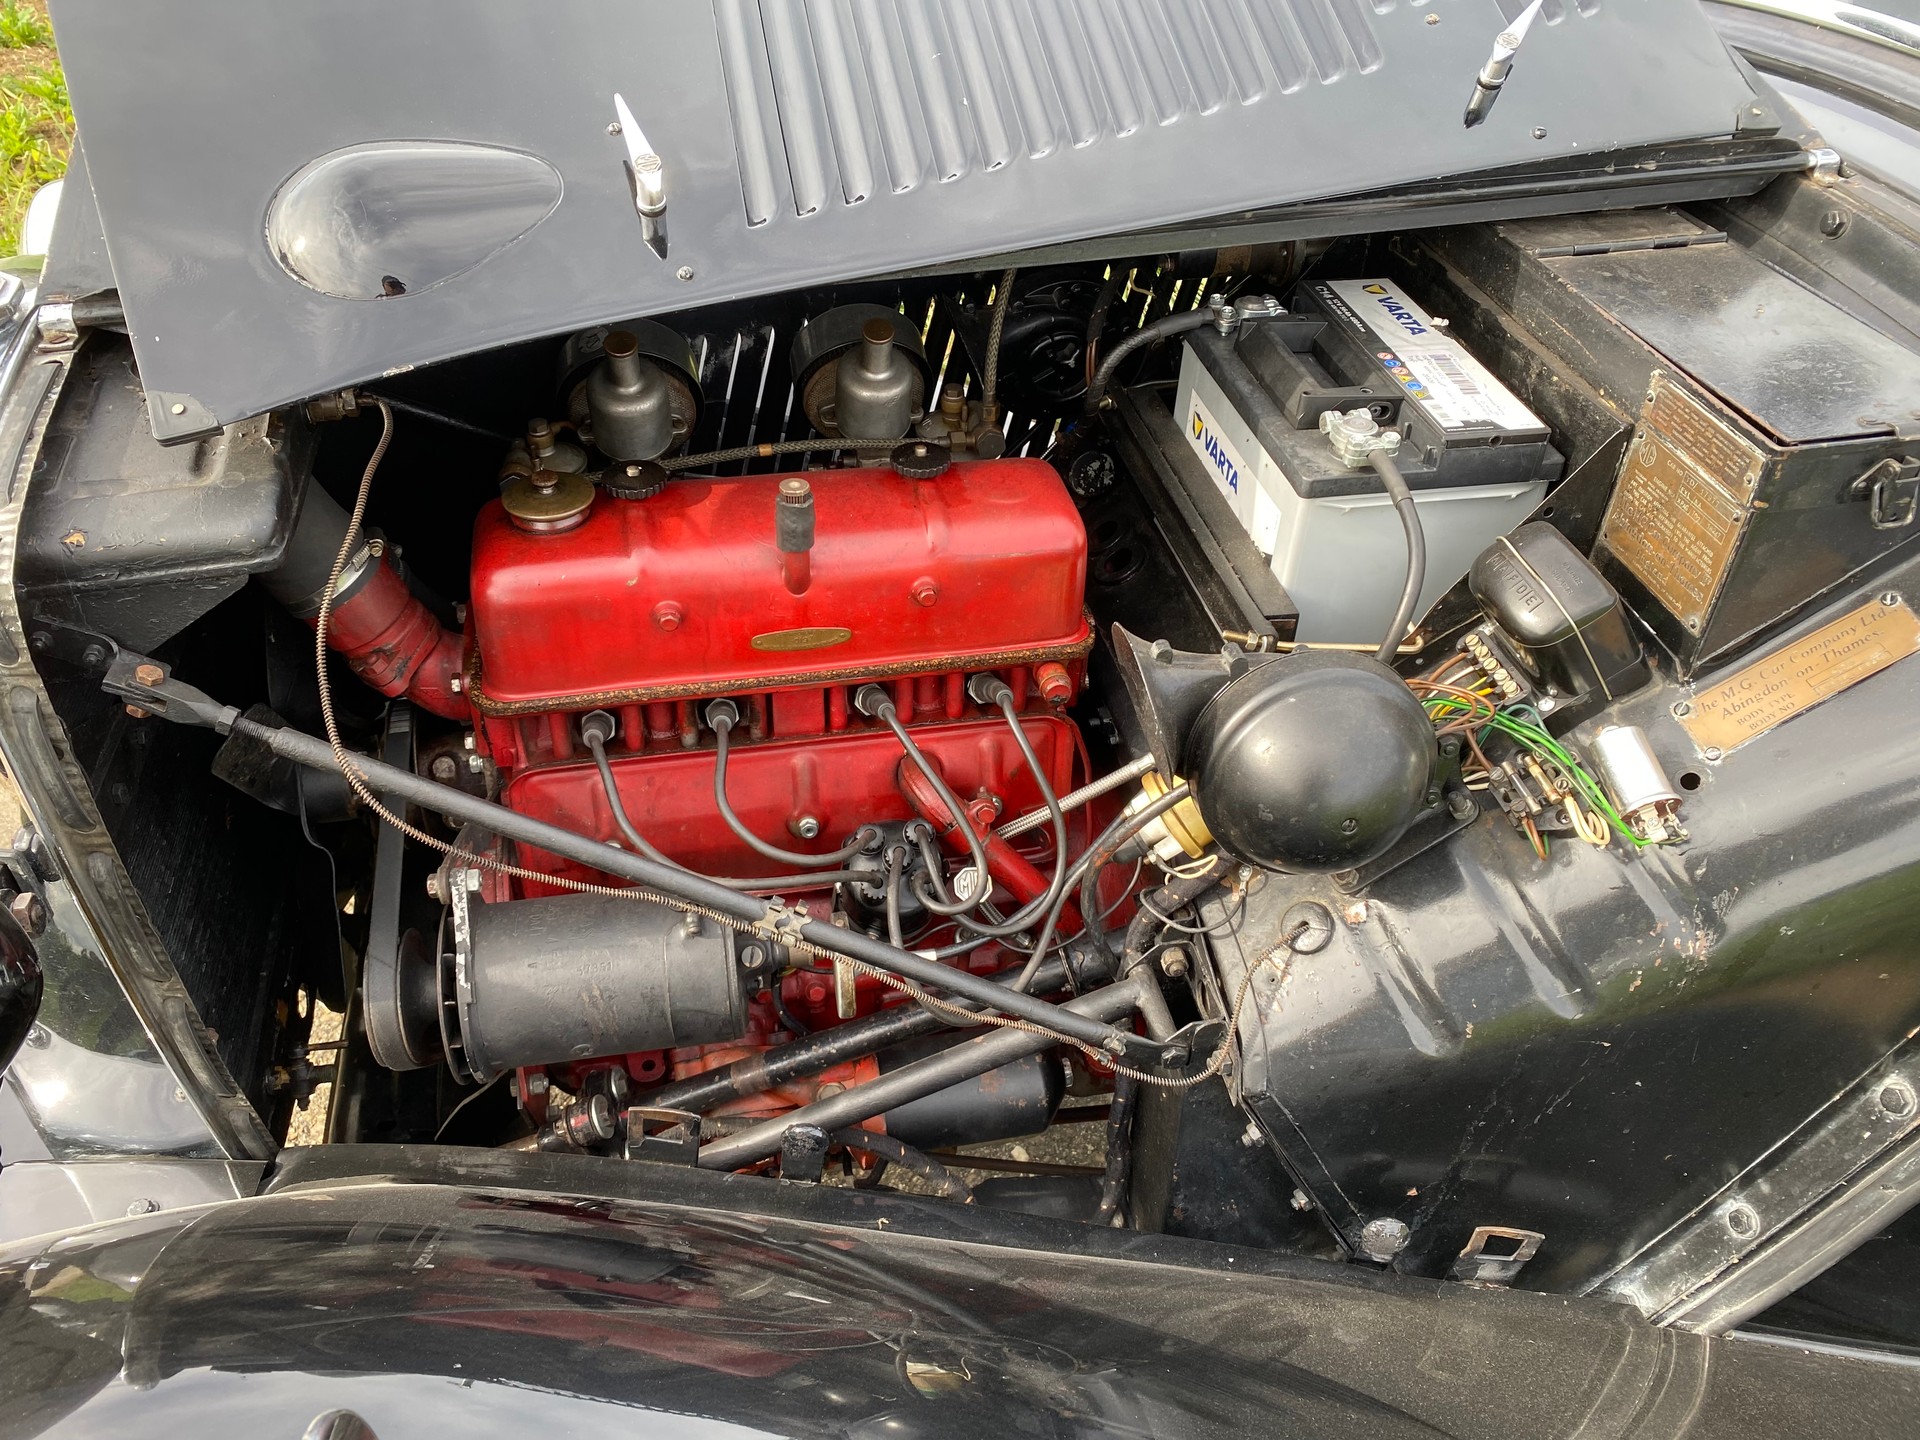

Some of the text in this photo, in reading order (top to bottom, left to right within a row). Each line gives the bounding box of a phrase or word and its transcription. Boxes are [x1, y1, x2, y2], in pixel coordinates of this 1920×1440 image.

[1377, 296, 1428, 337] VARTA
[1204, 427, 1239, 496] VARTA
[1637, 439, 1657, 468] MG
[1720, 677, 1757, 702] M.G.
[1759, 661, 1786, 679] Car
[1789, 624, 1859, 664] Company
[1721, 677, 1789, 720] Abingdon
[1736, 692, 1795, 726] BODY TYPE
[1749, 702, 1795, 731] BODY NO
